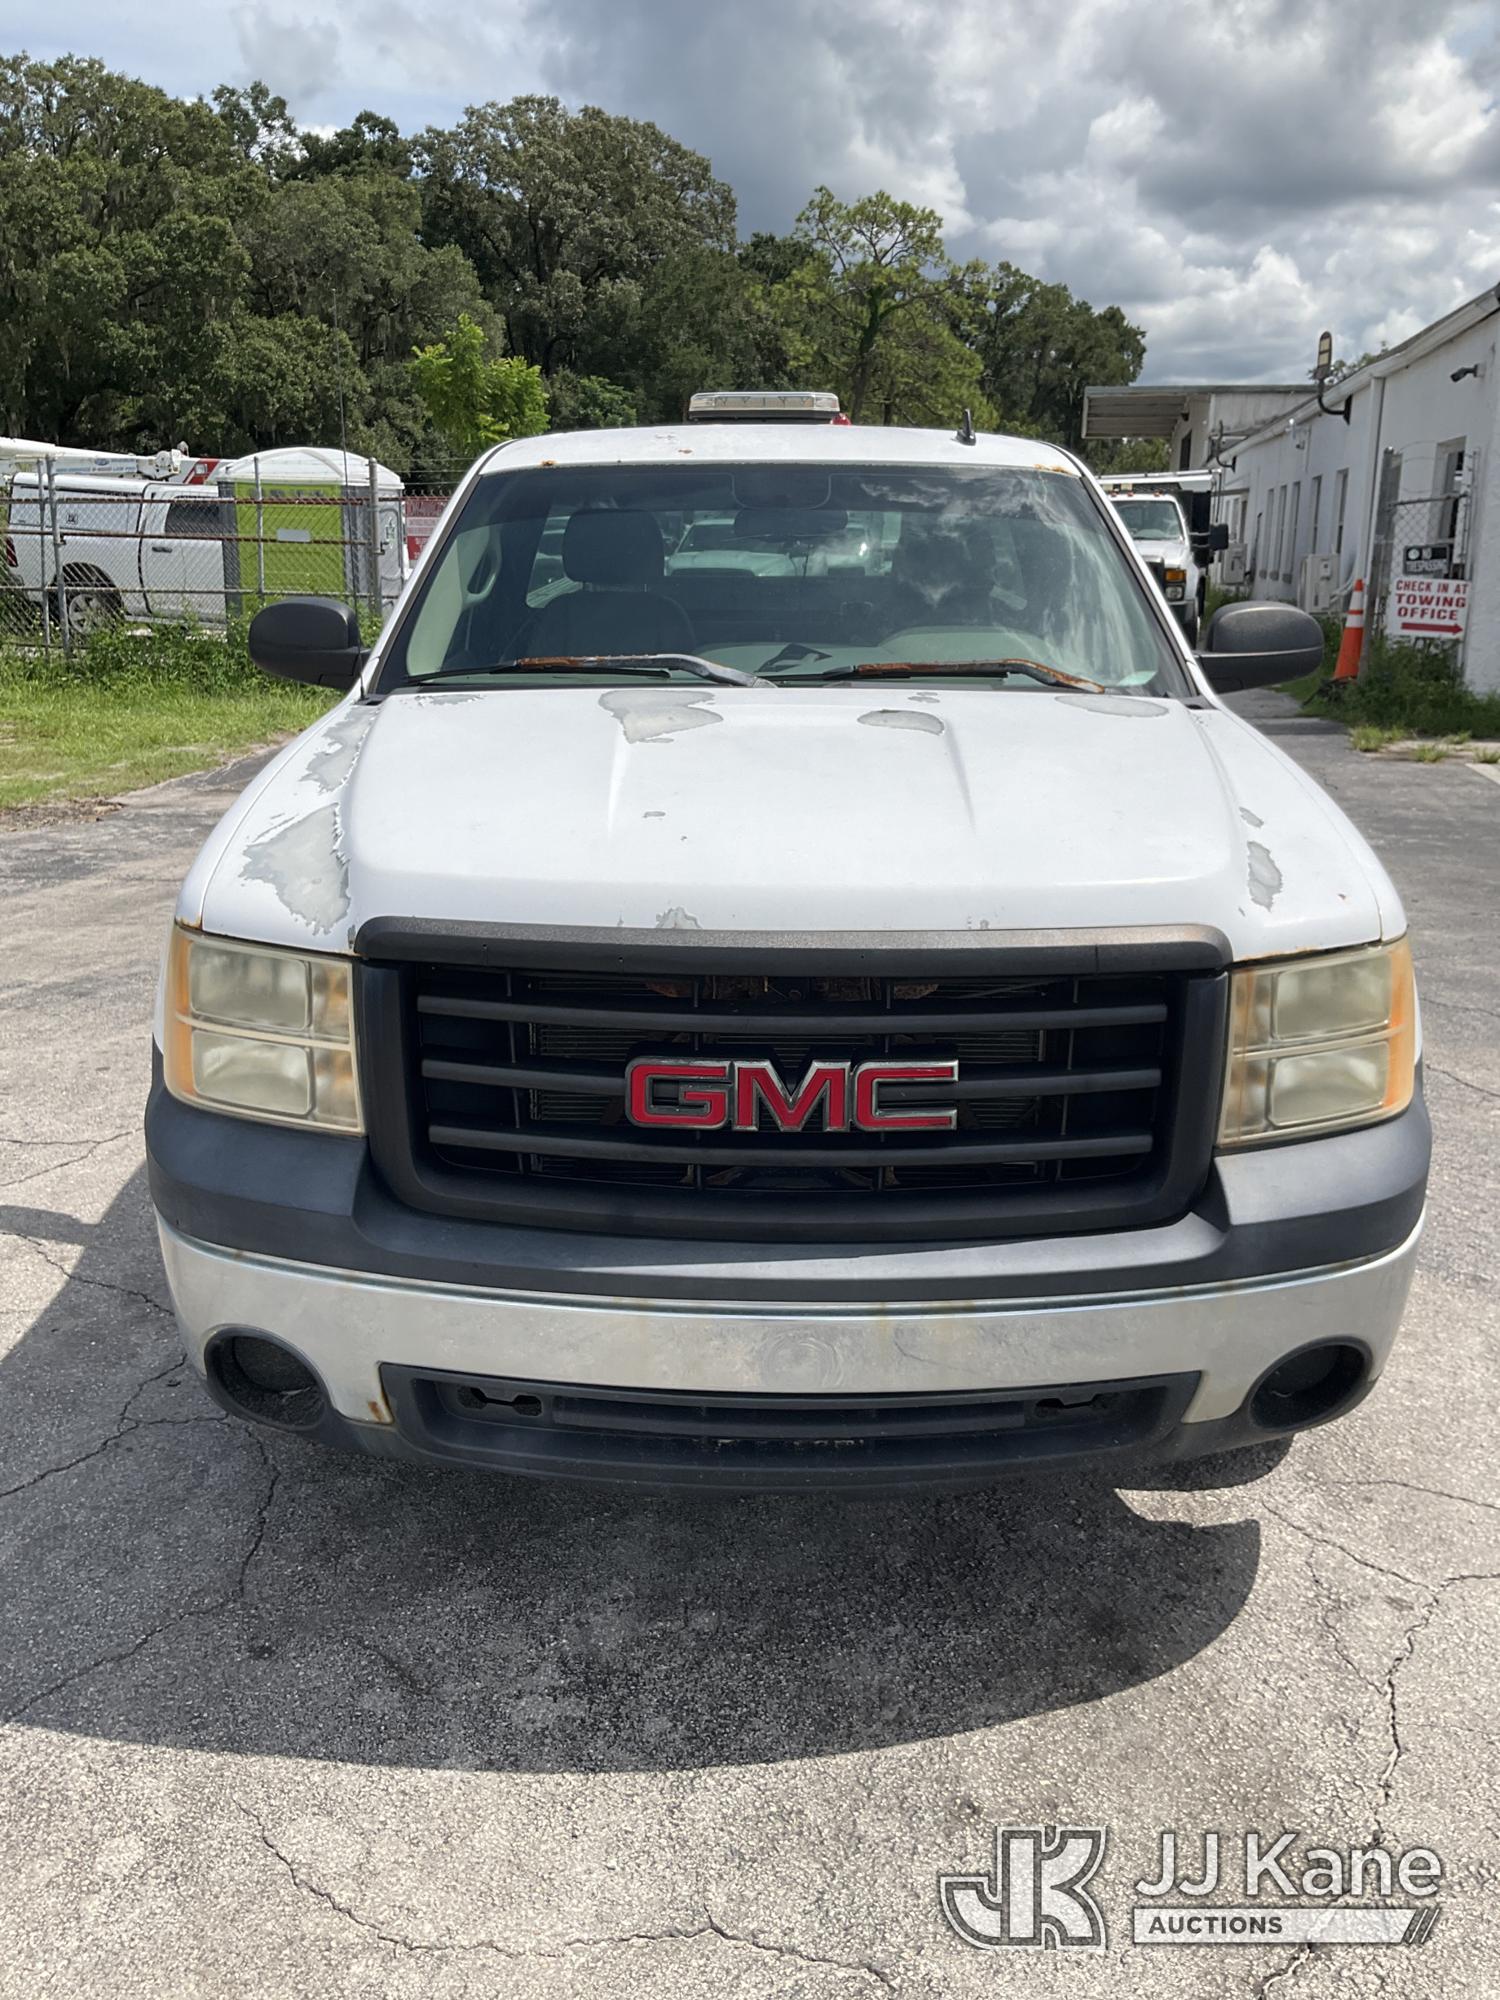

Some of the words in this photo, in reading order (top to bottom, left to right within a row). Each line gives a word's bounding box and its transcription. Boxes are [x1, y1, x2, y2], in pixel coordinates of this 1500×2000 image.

[1396, 580, 1432, 593] CHECK
[1437, 583, 1449, 593] IN
[1454, 584, 1469, 595] AT
[1396, 593, 1466, 608] TOWING
[1397, 606, 1458, 620] OFFICE
[625, 1056, 958, 1132] GMC
